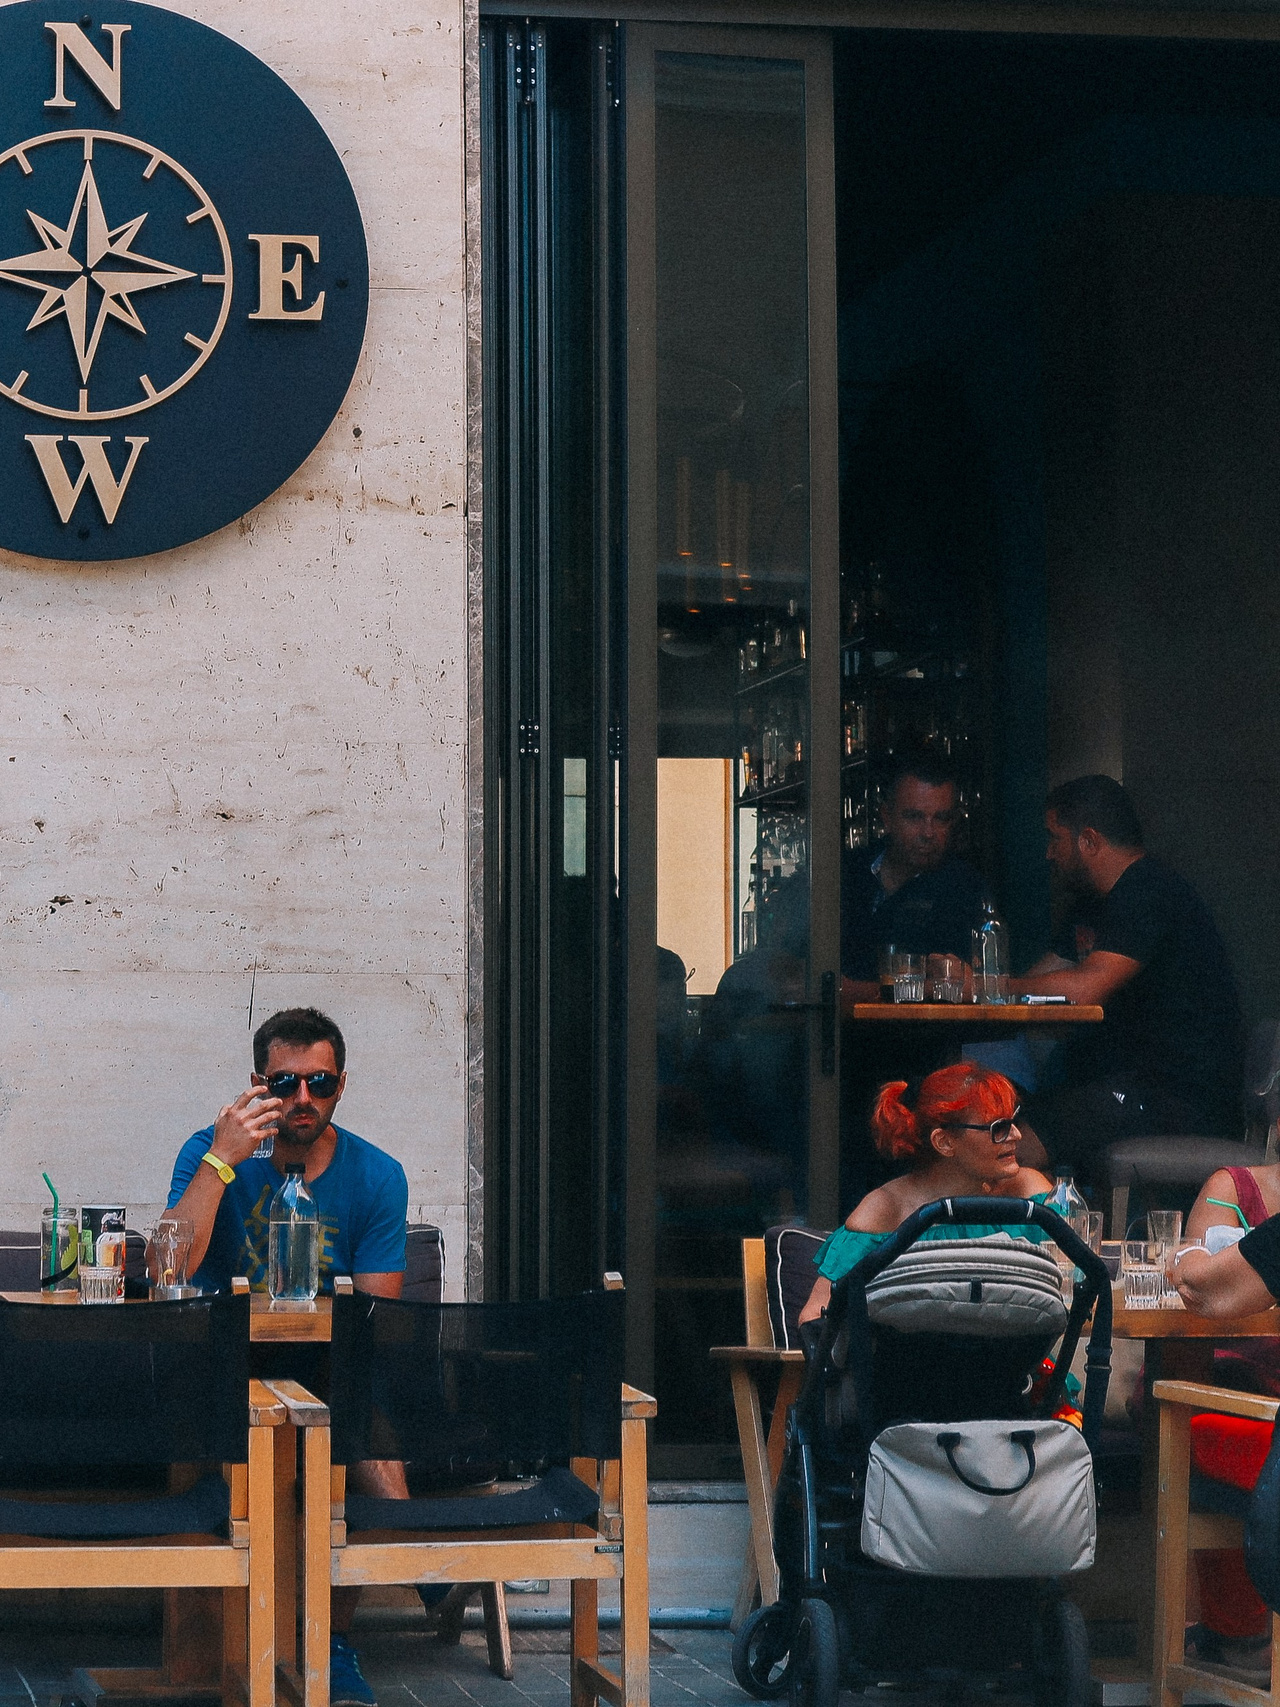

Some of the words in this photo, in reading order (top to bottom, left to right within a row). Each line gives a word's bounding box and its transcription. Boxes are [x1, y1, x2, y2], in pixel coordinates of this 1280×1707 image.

[44, 22, 131, 110] N
[248, 234, 325, 320] E
[24, 434, 149, 524] W
